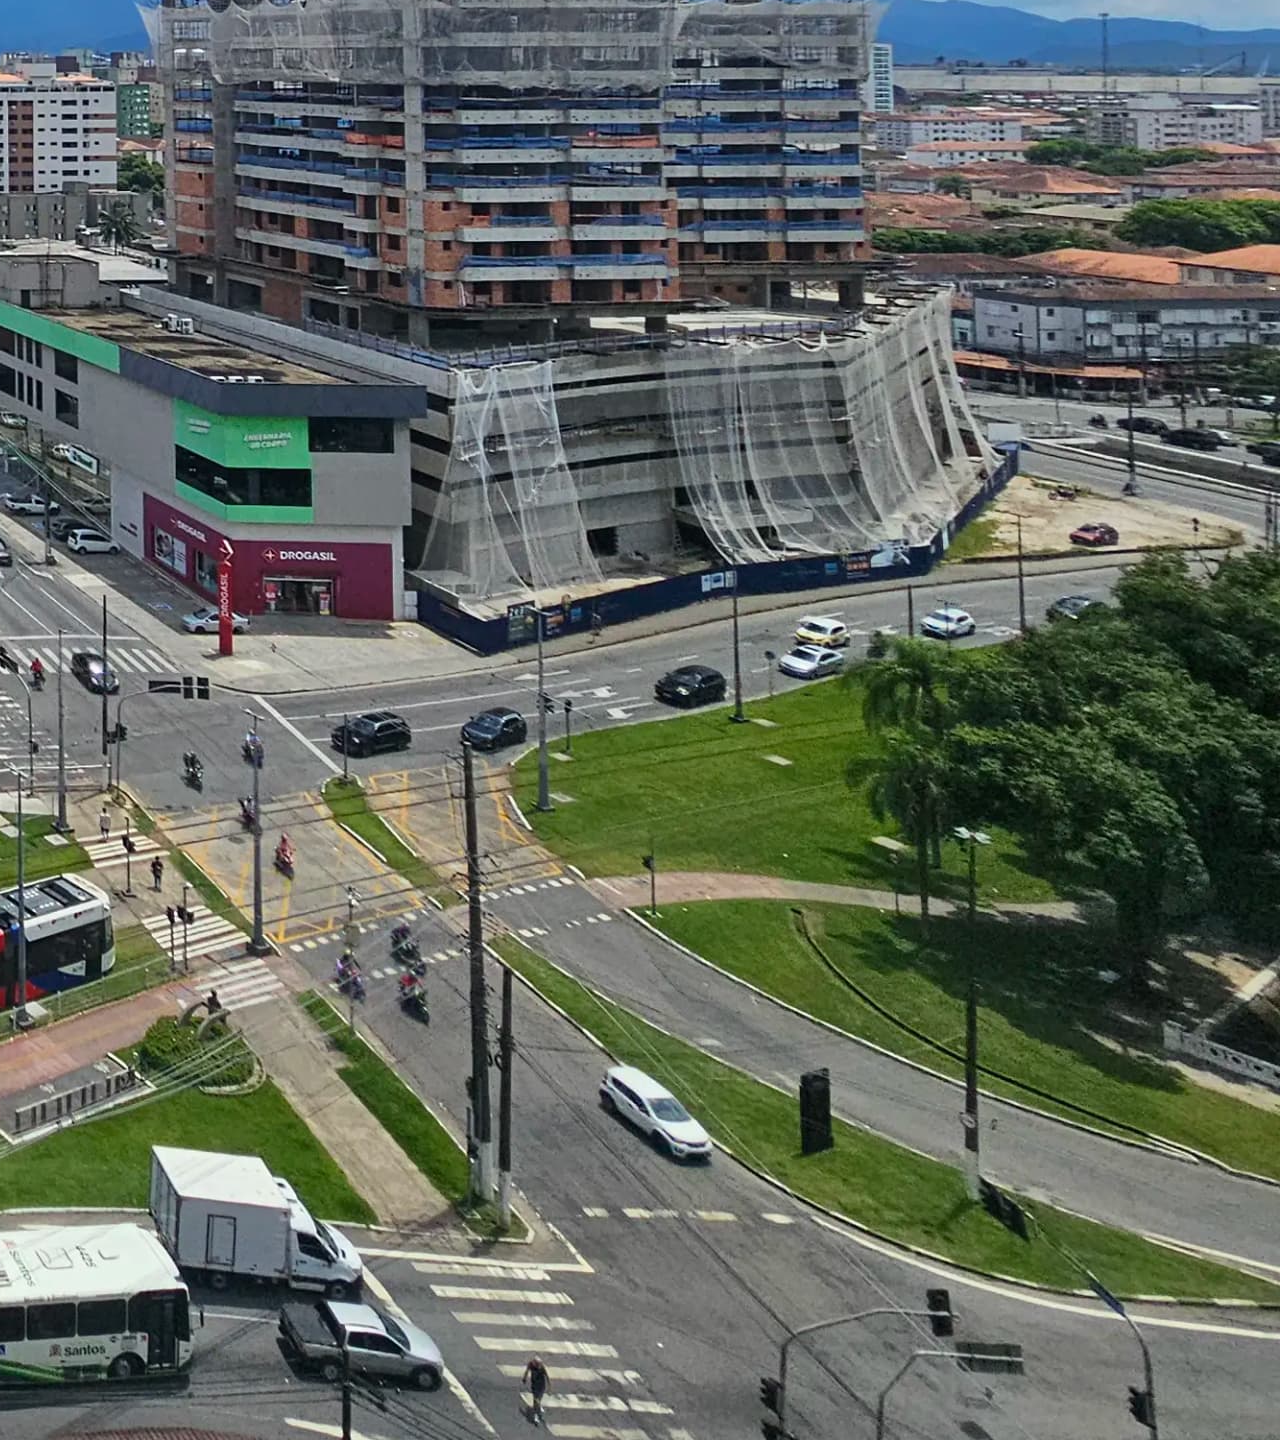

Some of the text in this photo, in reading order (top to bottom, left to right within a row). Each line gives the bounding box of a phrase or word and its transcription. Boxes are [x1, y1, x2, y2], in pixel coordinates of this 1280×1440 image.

[279, 550, 337, 561] DROGASIL
[220, 572, 229, 617] DROGASIL
[63, 1344, 106, 1357] Santos
